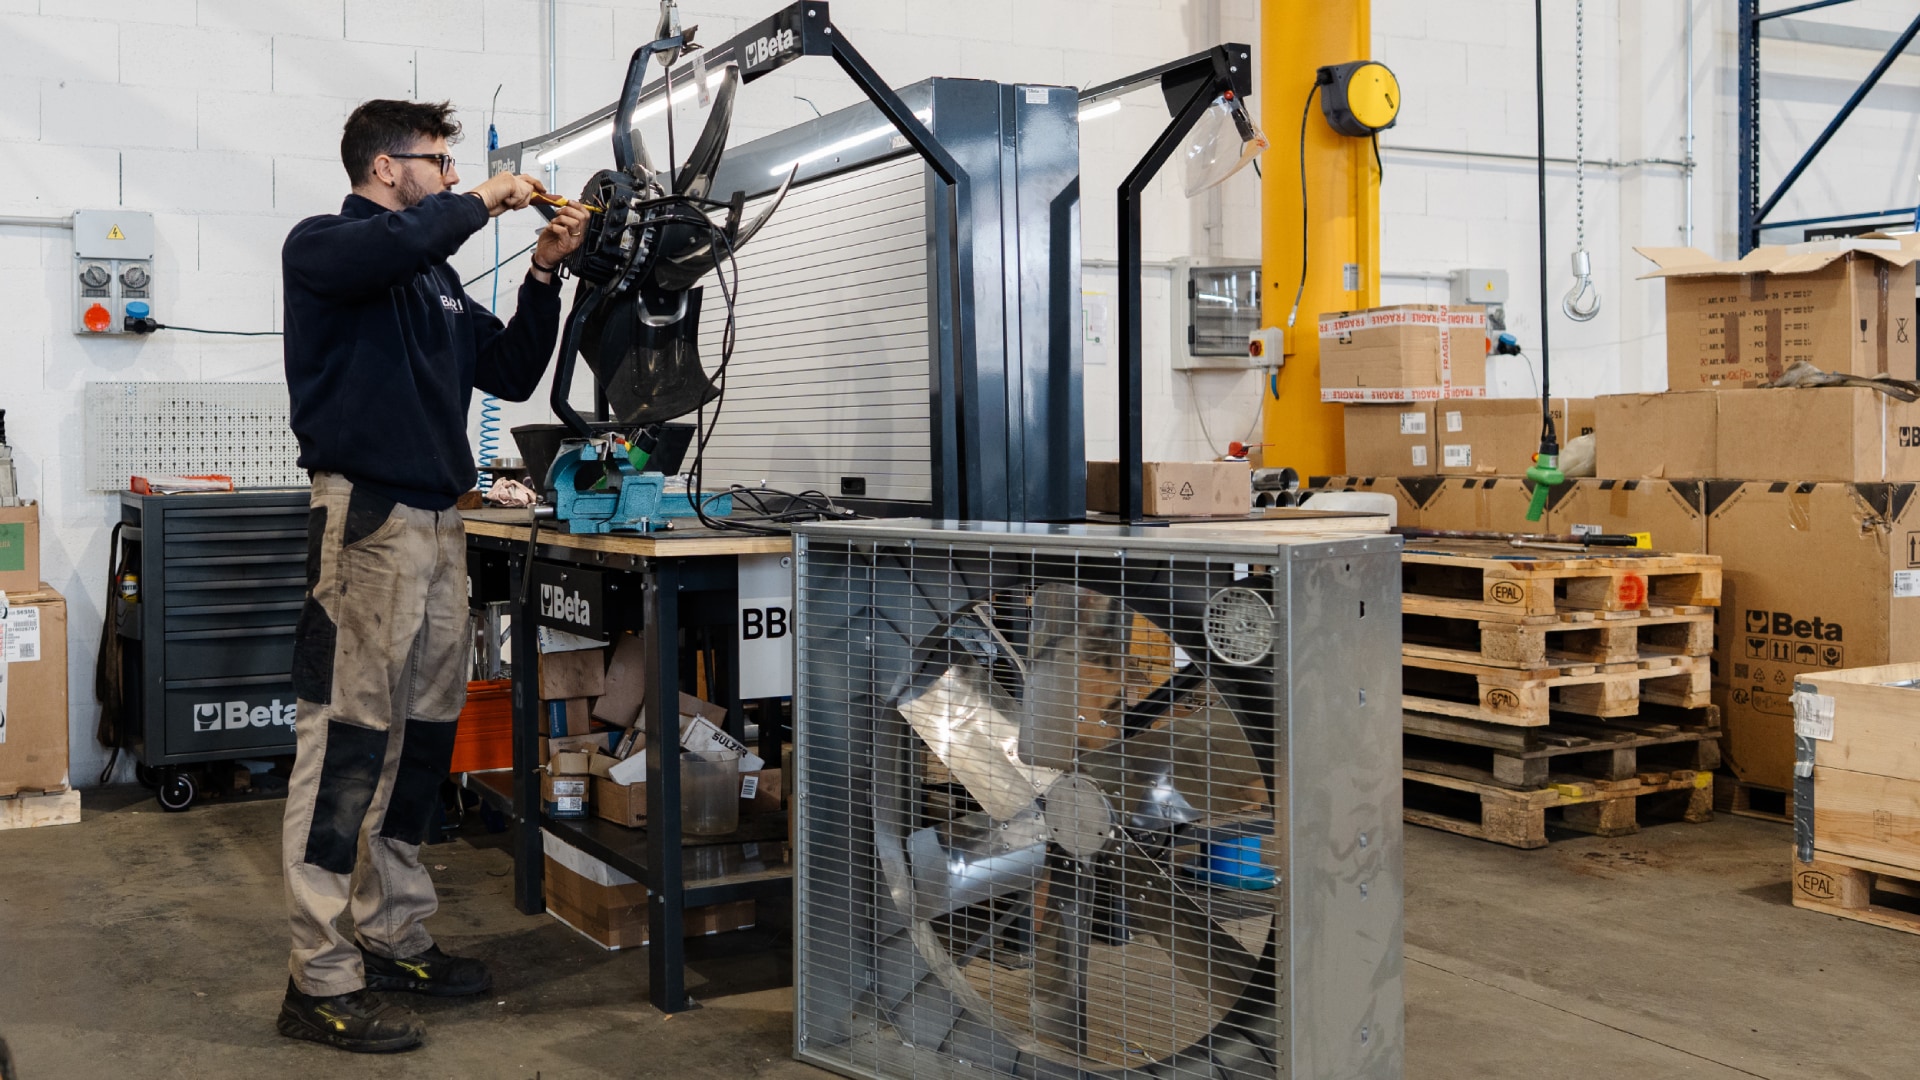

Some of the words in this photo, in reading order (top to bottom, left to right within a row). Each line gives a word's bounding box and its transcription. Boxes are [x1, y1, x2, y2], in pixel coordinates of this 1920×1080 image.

[757, 29, 794, 63] Beta
[1371, 312, 1406, 325] FRAGILE
[1442, 331, 1450, 370] FRAGILE
[554, 585, 590, 627] Beta
[1495, 586, 1518, 600] EPAL
[742, 607, 793, 641] BB
[1772, 611, 1843, 643] Beta
[225, 699, 297, 730] Beta
[1803, 874, 1835, 896] EPAL
